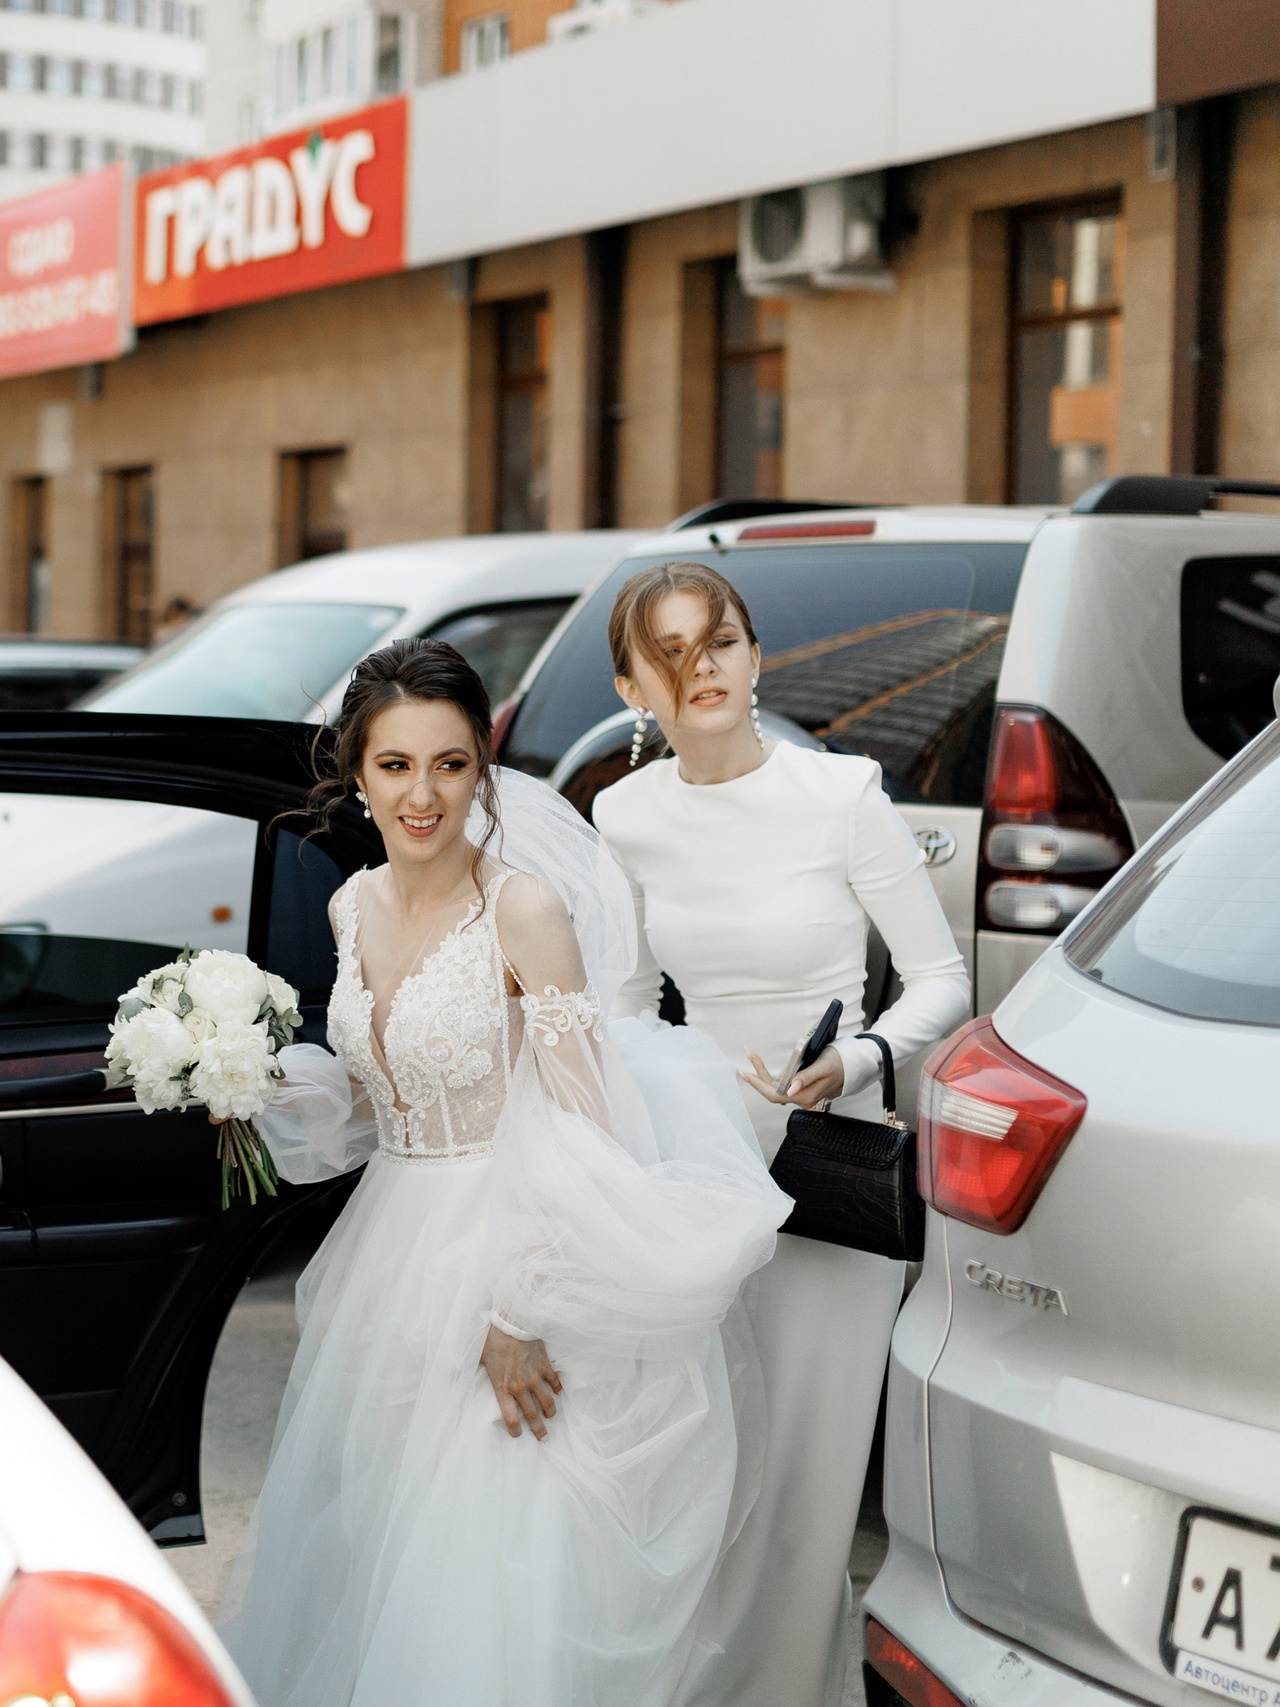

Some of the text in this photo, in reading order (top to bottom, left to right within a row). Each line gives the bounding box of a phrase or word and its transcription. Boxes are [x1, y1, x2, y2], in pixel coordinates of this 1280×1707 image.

[144, 130, 375, 285] ГРАДУС
[965, 1259, 1071, 1317] CRETA
[1183, 1659, 1270, 1707] Автоцентр
